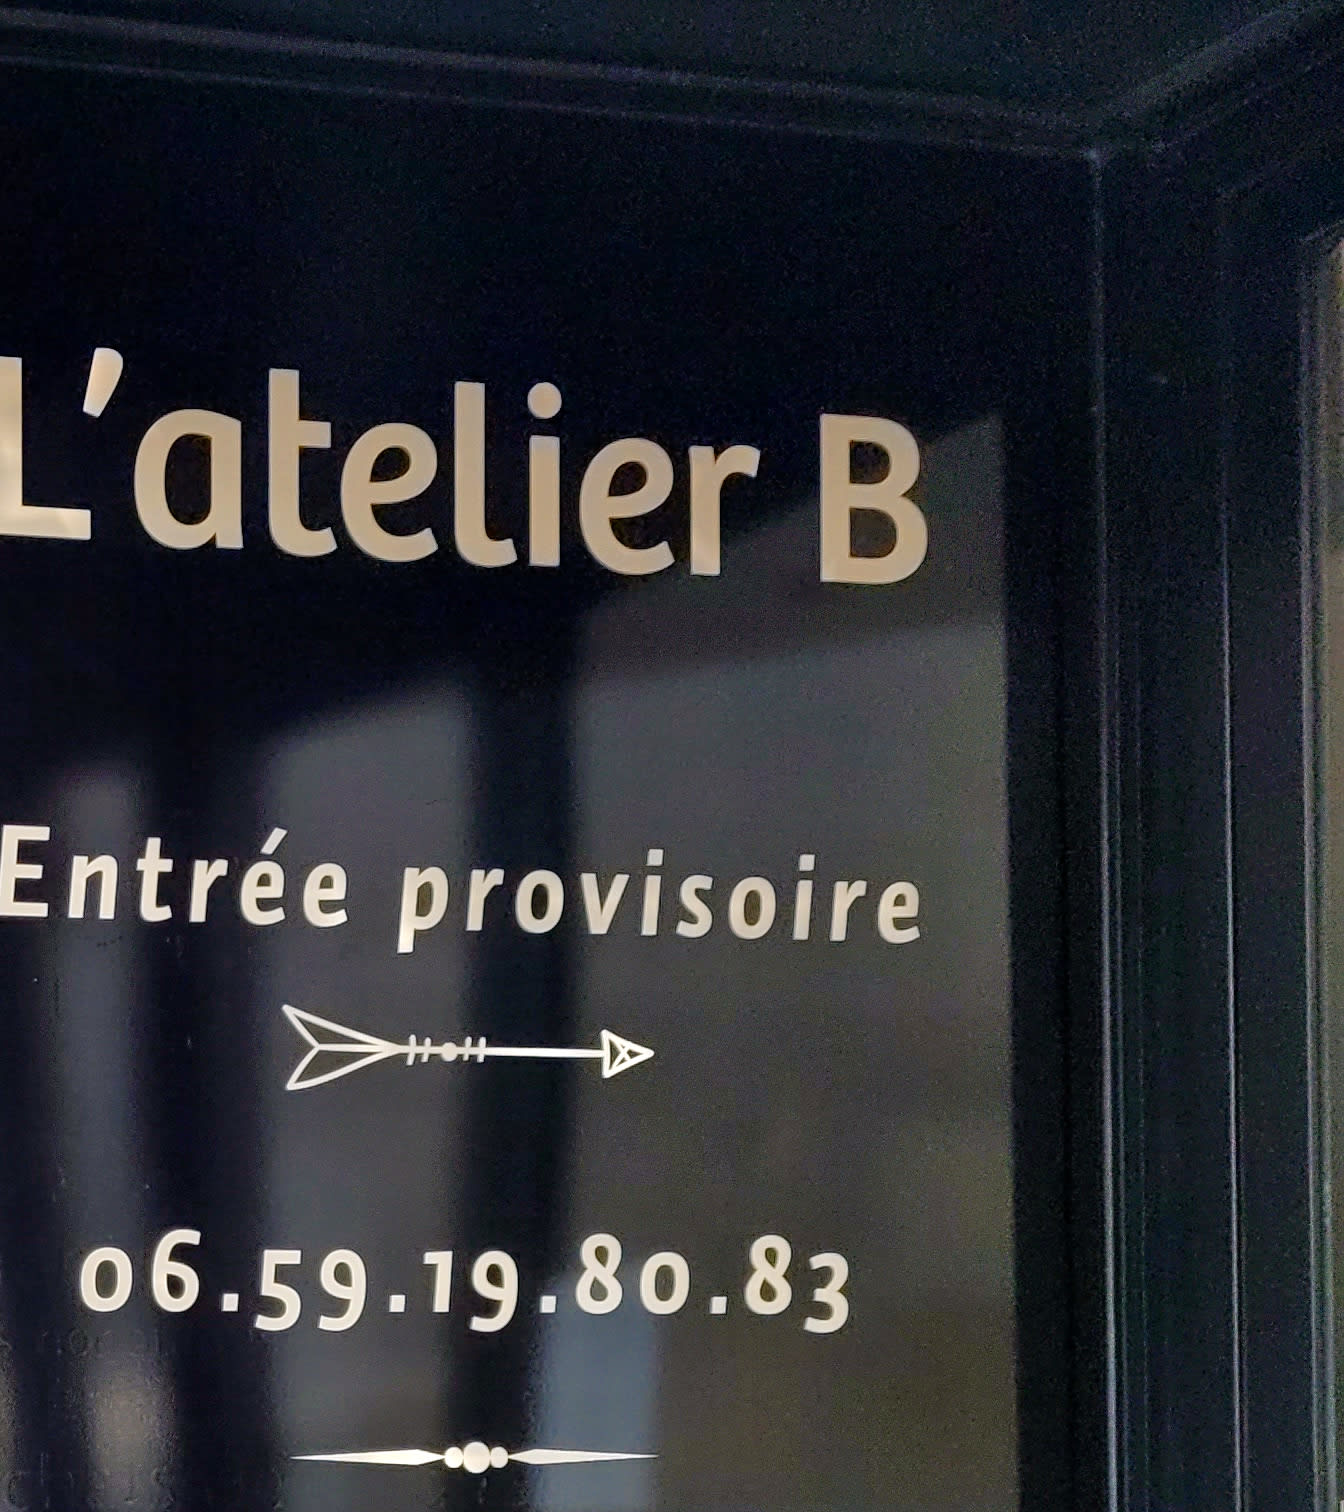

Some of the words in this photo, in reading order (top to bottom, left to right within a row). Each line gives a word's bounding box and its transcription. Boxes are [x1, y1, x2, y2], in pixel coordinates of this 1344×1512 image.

[820, 413, 928, 583] B
[397, 848, 921, 954] provisoire
[80, 1229, 850, 1333] 06.59.19.80.83
